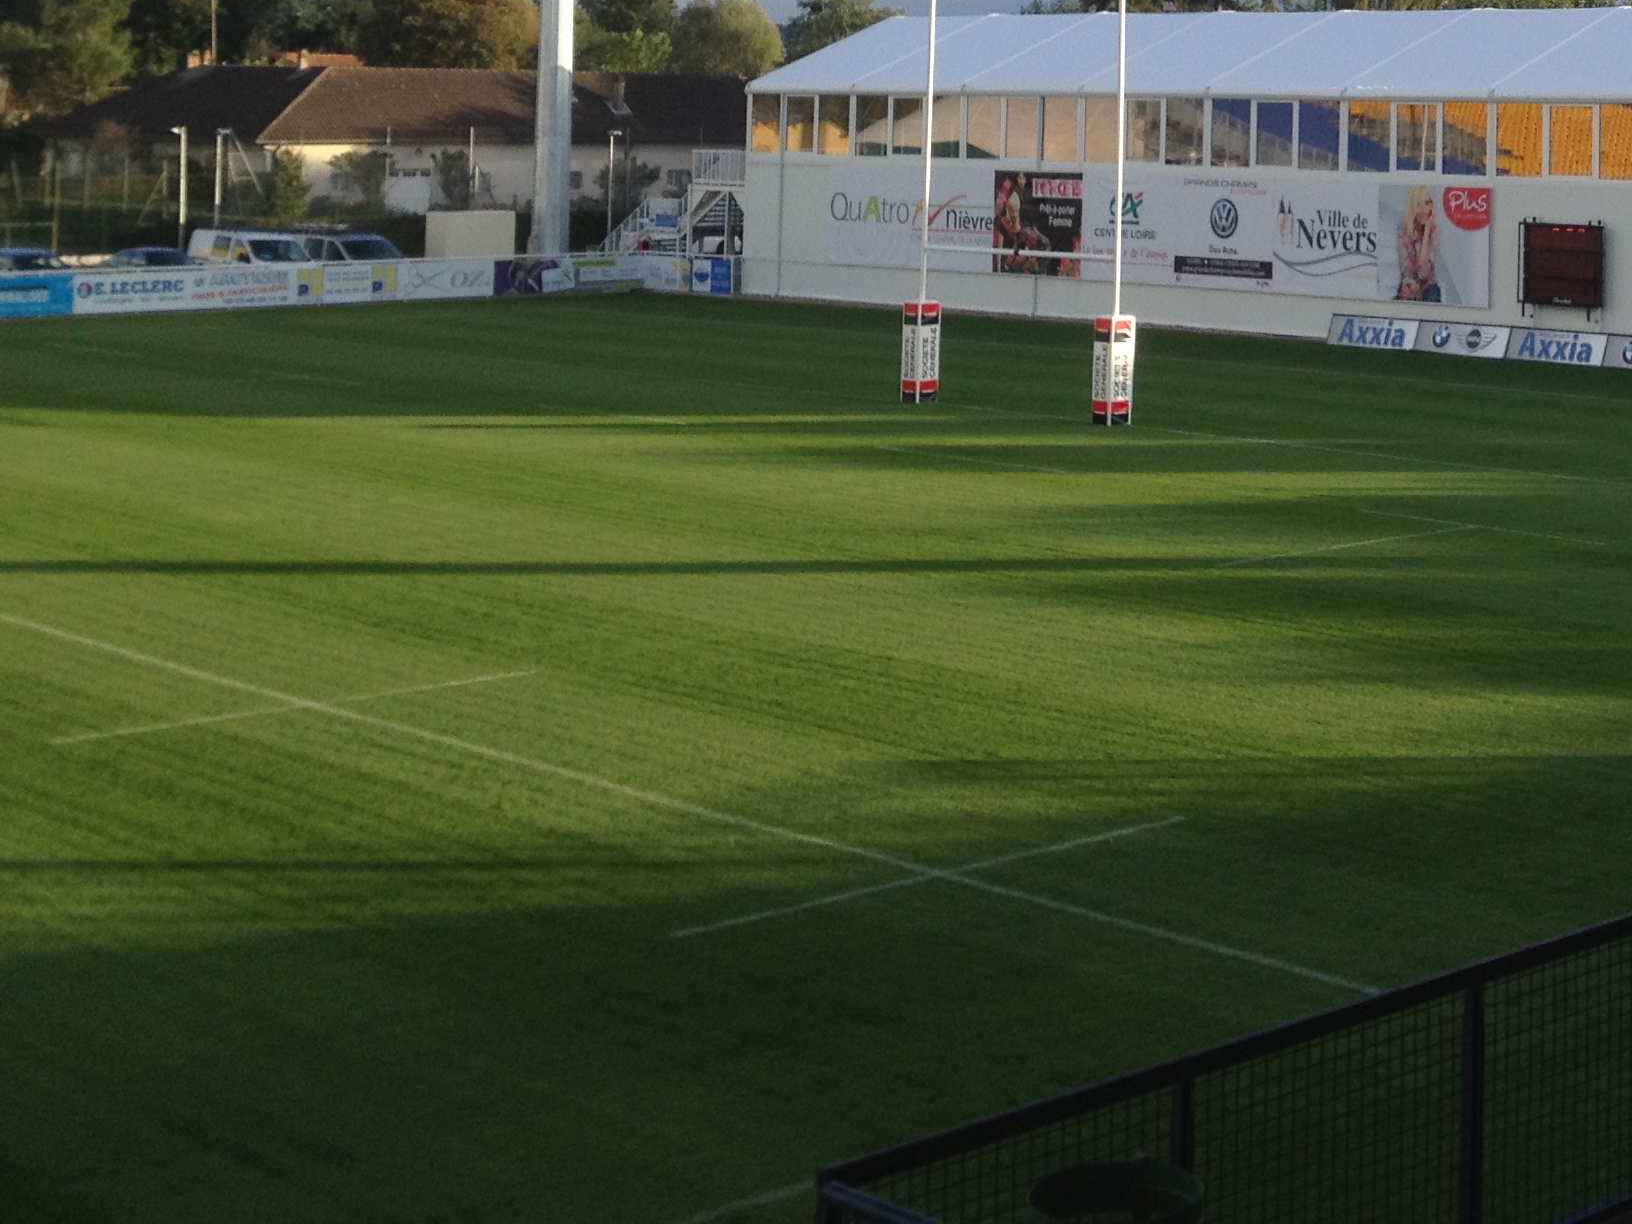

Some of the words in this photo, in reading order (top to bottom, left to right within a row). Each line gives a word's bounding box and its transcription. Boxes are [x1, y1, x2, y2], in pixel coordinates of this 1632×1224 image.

[1449, 190, 1487, 213] Plus
[1317, 209, 1350, 229] Ville
[1352, 213, 1368, 229] de
[1094, 228, 1129, 239] CENTE
[1296, 218, 1377, 253] Nevers
[1337, 318, 1405, 348] Axxia
[1518, 332, 1592, 363] Axxia
